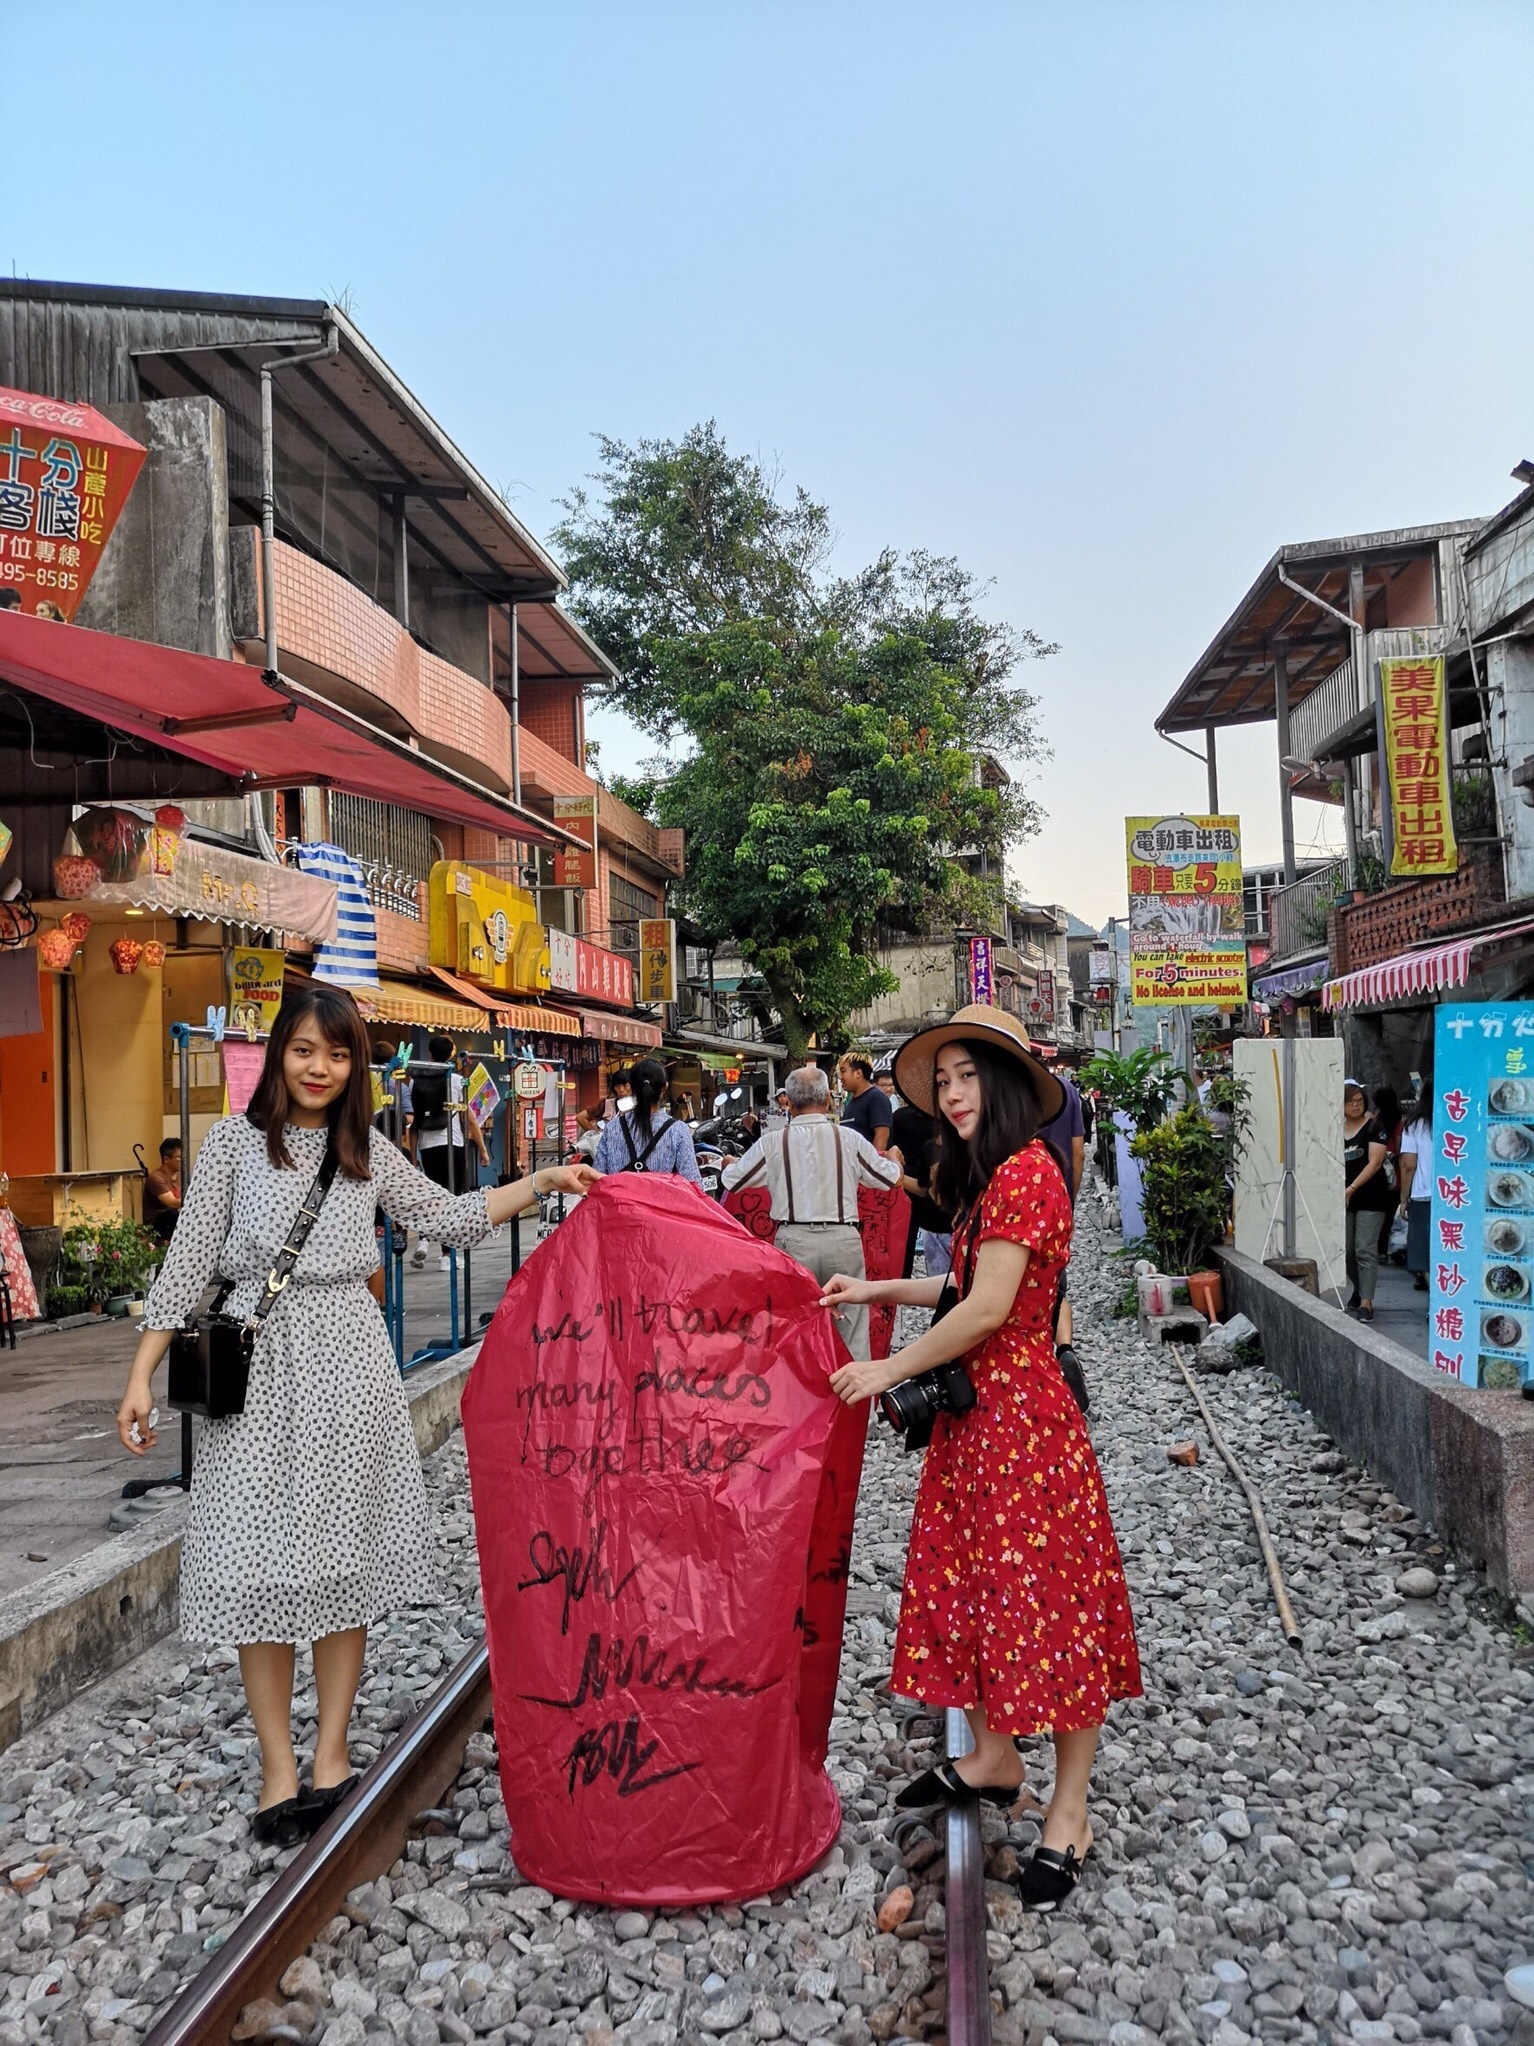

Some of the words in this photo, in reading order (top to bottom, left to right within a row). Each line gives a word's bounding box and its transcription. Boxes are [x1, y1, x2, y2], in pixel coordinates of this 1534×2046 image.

[0, 427, 83, 491] 十分
[80, 447, 108, 545] 山產小吃
[1390, 665, 1446, 865] 美果電動車出租
[1136, 829, 1233, 851] 電動車出租
[1133, 934, 1145, 942] Go
[1148, 933, 1159, 942] to
[1161, 932, 1203, 942] waterfall
[1221, 932, 1242, 941] walk
[1133, 942, 1167, 951] around
[1133, 952, 1148, 961] You
[1150, 953, 1164, 961] can
[1167, 951, 1184, 961] take
[1185, 953, 1214, 963] electric
[1136, 968, 1161, 979] For
[1161, 962, 1178, 984] 5
[1180, 966, 1244, 978] minutes.
[243, 989, 280, 1001] FOOD
[1136, 984, 1150, 998] No
[1153, 983, 1185, 998] license
[1188, 982, 1205, 997] and
[1208, 982, 1243, 996] helmet.
[633, 1294, 771, 1349] travel
[516, 1379, 621, 1440] many
[632, 1346, 771, 1436] places
